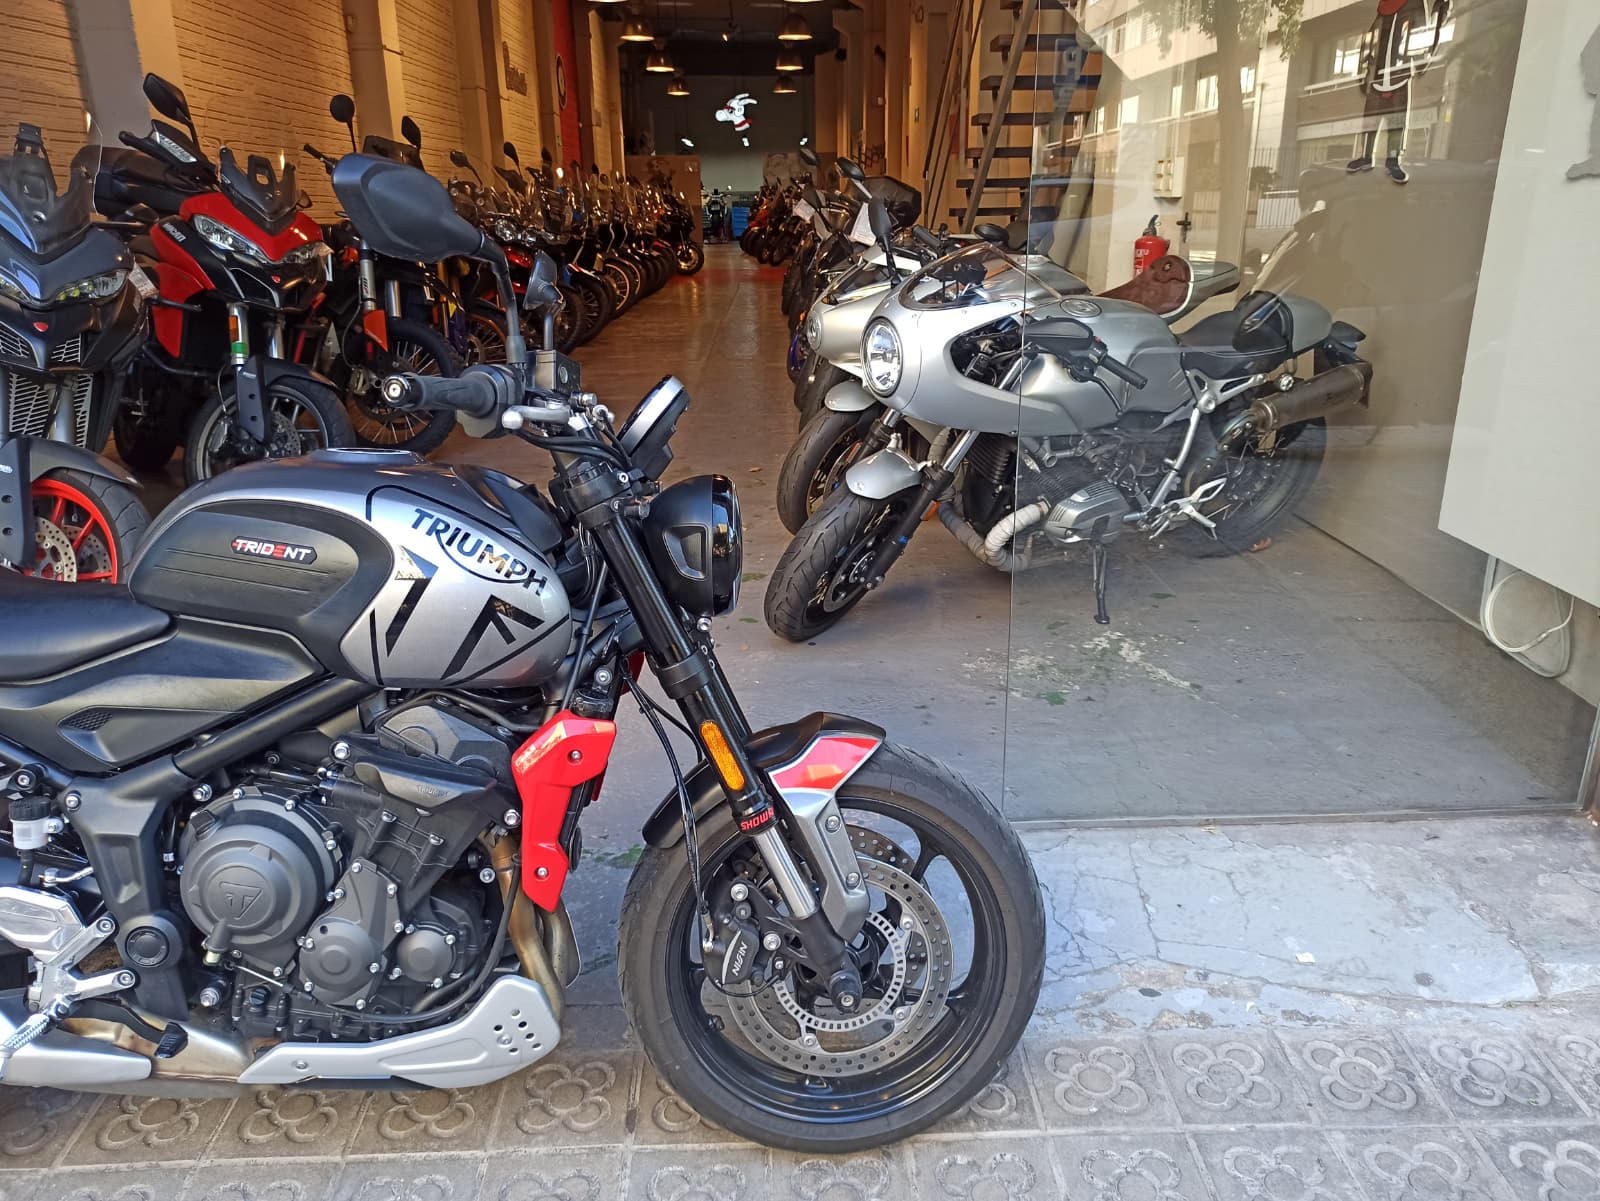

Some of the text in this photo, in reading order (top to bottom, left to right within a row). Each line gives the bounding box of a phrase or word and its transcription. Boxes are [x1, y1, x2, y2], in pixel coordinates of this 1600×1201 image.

[232, 539, 311, 561] TRIDENT
[411, 508, 548, 596] TRIUMPH
[740, 807, 775, 831] SHOWA
[732, 940, 747, 976] NISSIN
